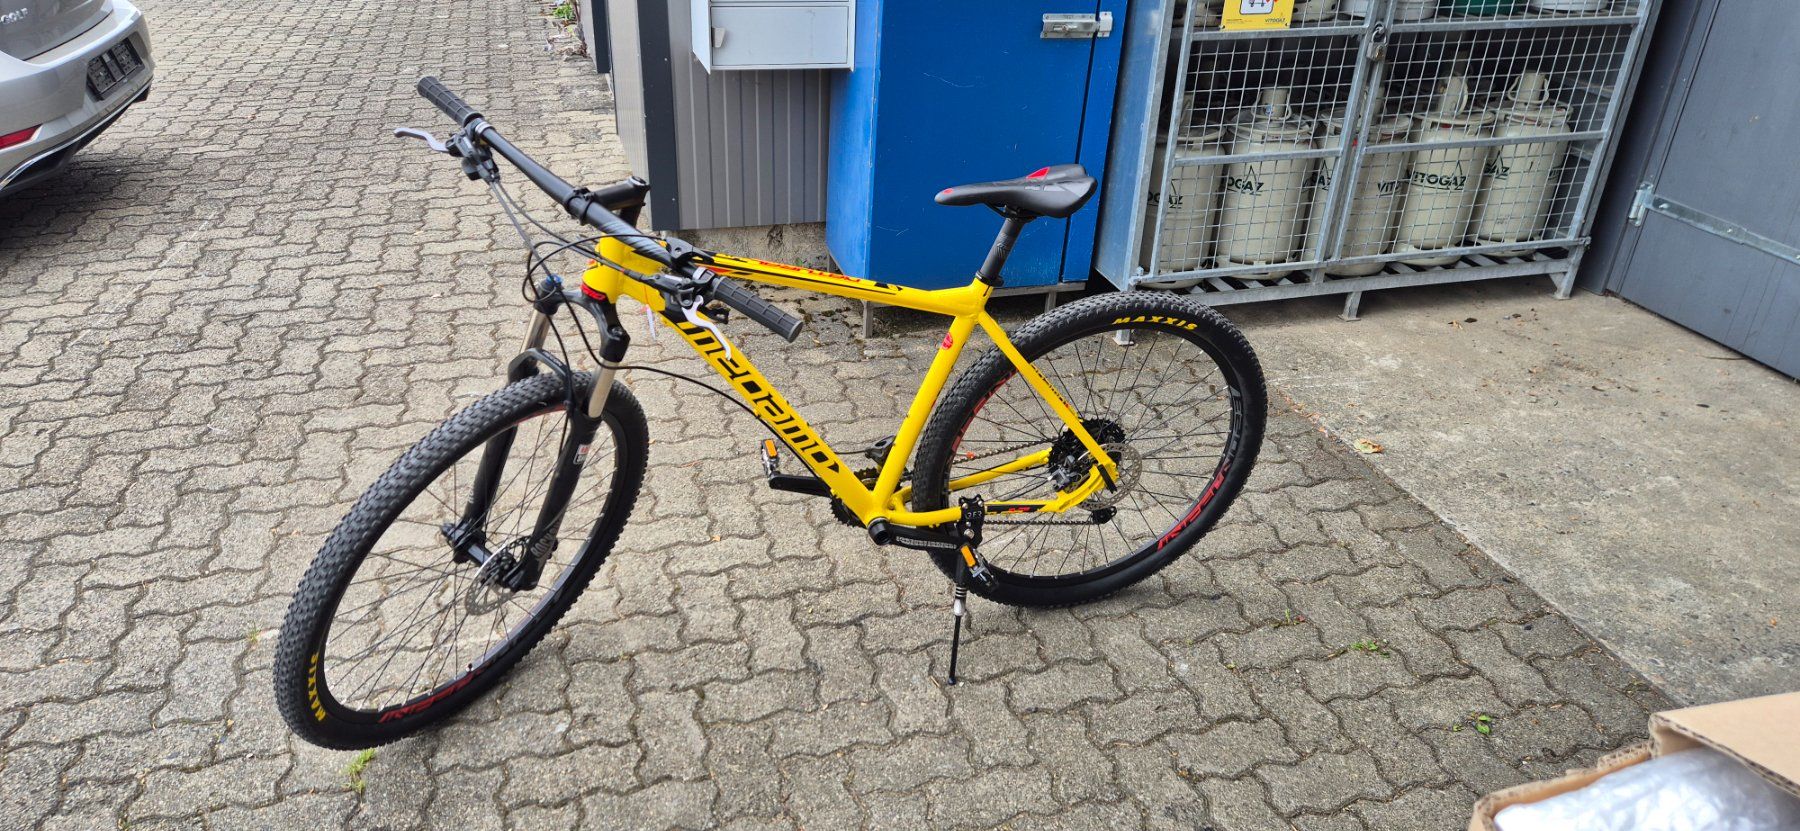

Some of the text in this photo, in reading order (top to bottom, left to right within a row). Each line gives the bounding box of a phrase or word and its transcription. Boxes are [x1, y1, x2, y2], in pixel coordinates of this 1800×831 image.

[0, 7, 28, 24] GOLF
[1403, 169, 1467, 188] VITOGAZ
[1111, 315, 1198, 330] MAXXIS
[307, 651, 326, 721] MAXXIS
